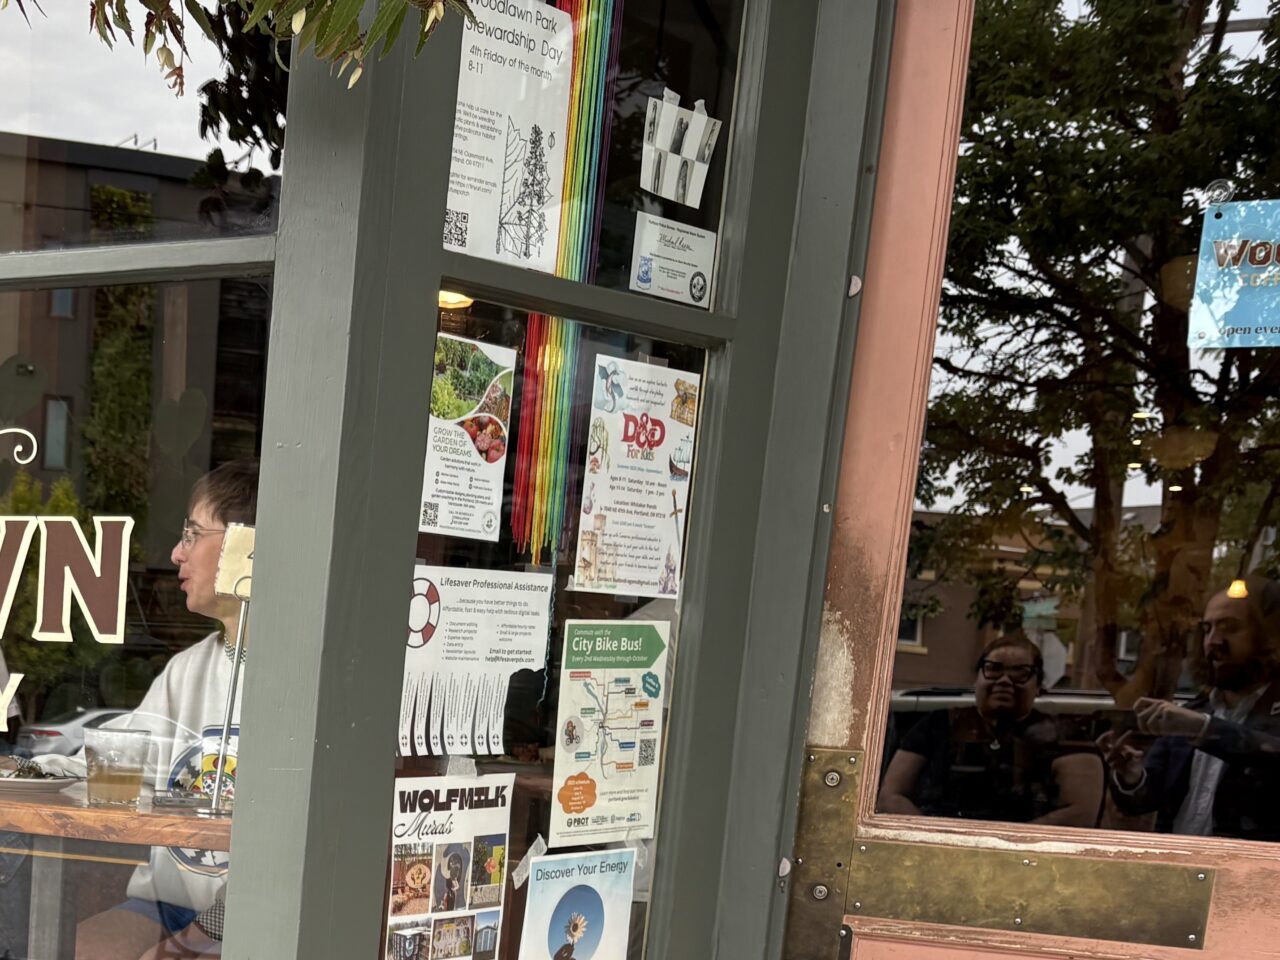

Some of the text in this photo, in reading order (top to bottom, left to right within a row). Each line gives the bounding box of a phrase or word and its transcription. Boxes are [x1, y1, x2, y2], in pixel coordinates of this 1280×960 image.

[535, 10, 558, 34] Park
[469, 44, 553, 81] 4th Friday of the month
[541, 40, 563, 65] Day
[468, 60, 484, 75] 8-11
[433, 426, 466, 440] GROW THE
[433, 435, 468, 448] GARDEN OF
[621, 412, 666, 451] D&D
[433, 444, 472, 458] YOUR DREAMS
[627, 444, 655, 462] For Kids
[440, 578, 548, 592] Lifesaver Professional Assistance
[572, 636, 642, 655] City Bike Bus!
[398, 785, 508, 814] WOLFMILK
[394, 811, 454, 840] Murals
[536, 860, 628, 882] Discover Your Energy
